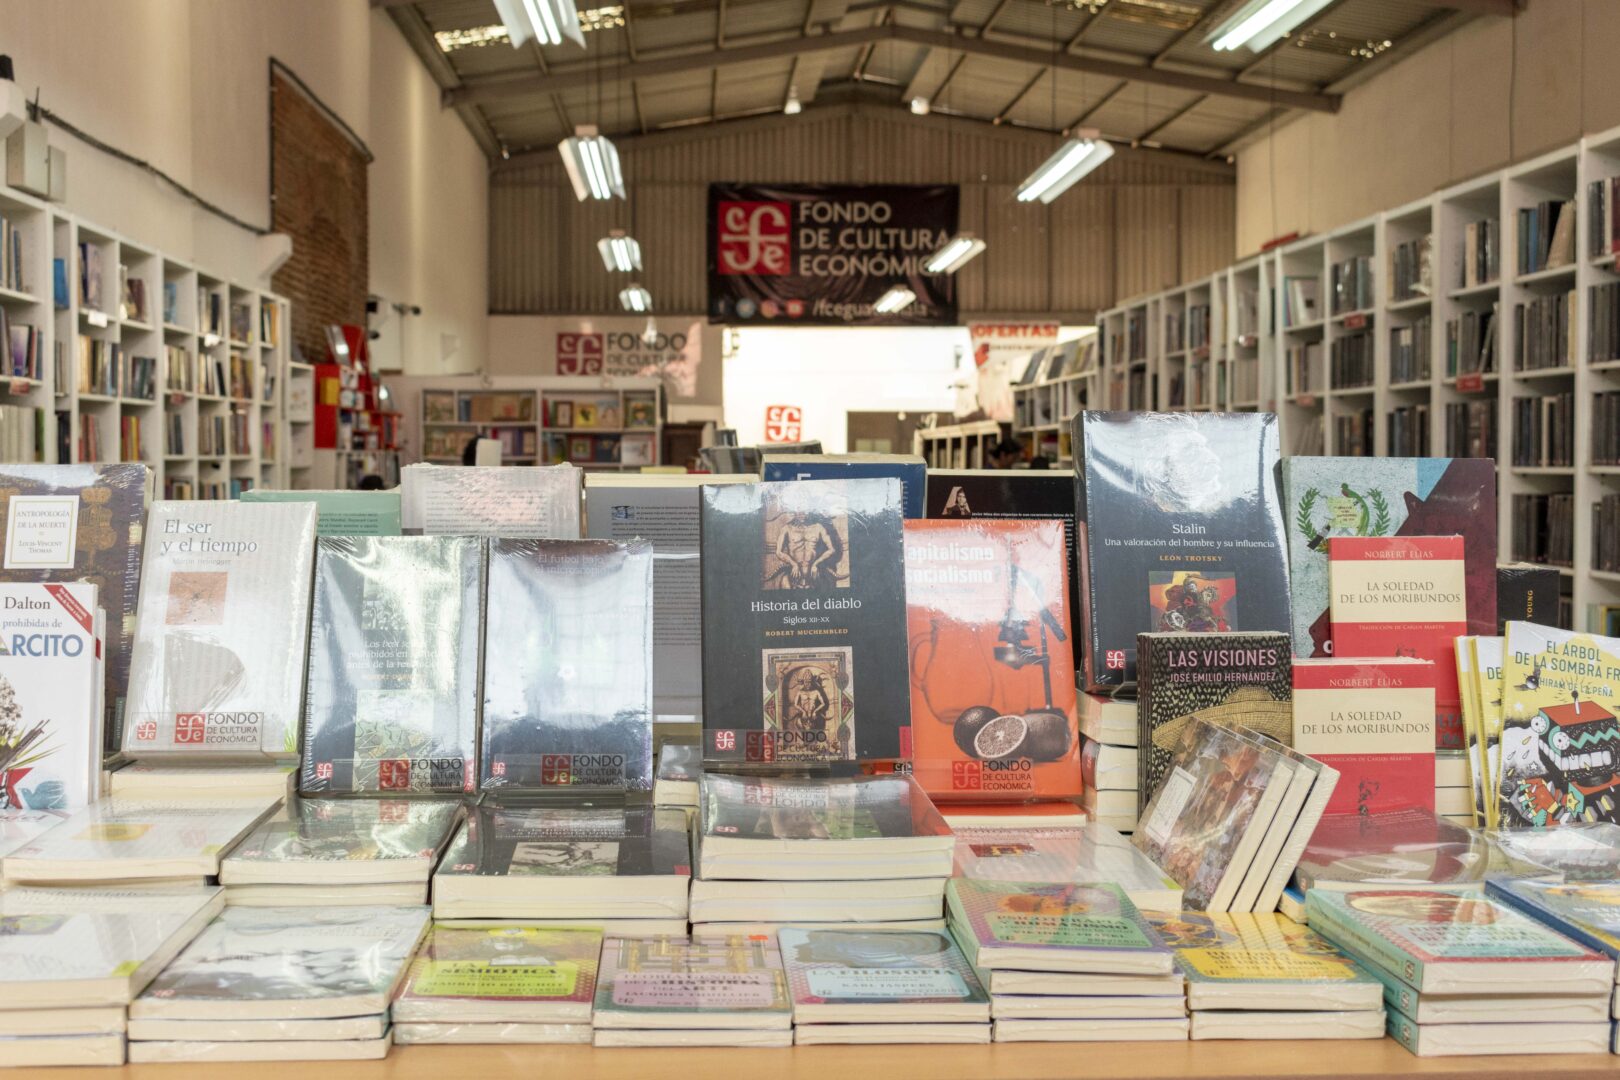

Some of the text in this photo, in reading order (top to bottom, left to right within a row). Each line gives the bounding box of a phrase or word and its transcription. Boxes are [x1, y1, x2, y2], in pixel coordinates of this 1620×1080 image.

[800, 201, 891, 224] FONDO
[800, 228, 950, 250] DE CULTURA
[800, 252, 938, 276] ECONÓMIC
[607, 332, 688, 351] FONDO
[17, 521, 67, 529] DE LA MUERTE
[164, 519, 213, 534] El ser
[1172, 523, 1206, 535] Stalin
[160, 537, 258, 556] y el tiempo
[1104, 538, 1122, 547] Una
[1123, 537, 1167, 547] valoración
[1168, 538, 1182, 547] del
[1183, 538, 1215, 548] hombre
[1216, 541, 1222, 549] y
[1235, 539, 1275, 548] influencia
[909, 542, 995, 563] apitalismo
[1364, 550, 1434, 559] NORBERT ELIAS
[1367, 581, 1434, 591] LA SOLEDAD
[4, 596, 51, 610] Dalton
[751, 597, 862, 612] Historia del diablo
[1340, 593, 1461, 604] DE LOS MORIBUNDOS
[1526, 589, 1534, 619] YOUNG
[2, 618, 63, 630] prohibidas de
[783, 615, 808, 626] Siglos
[797, 628, 849, 637] MUCHEMBLED
[1546, 640, 1602, 662] EL ÁRBOL
[1169, 649, 1277, 668] LAS VISIONES
[1515, 651, 1530, 666] DE
[1533, 654, 1547, 669] LA
[1551, 657, 1602, 679] SOMBRA
[1169, 670, 1276, 683] JOSÉ EMILIO HERNÁNDEZ
[1329, 678, 1403, 687] NORBERT ELIAS
[1539, 677, 1566, 690] HIRAM
[1592, 685, 1614, 698] PEÑA
[207, 712, 259, 725] FONDO
[1330, 711, 1402, 721] LA SOLEDAD
[207, 726, 258, 734] DE CULTURA
[1302, 723, 1430, 735] DE LOS MORIBUNDOS
[206, 734, 257, 743] ECONÓMICA
[776, 731, 827, 742] FONDO
[411, 758, 462, 771] FONDO
[573, 755, 623, 767] FONDO
[982, 760, 1031, 772] FONDO
[411, 771, 462, 780] DE CULTURA
[573, 767, 623, 776] DE CULTURA
[982, 773, 1032, 781] DE CULTURA
[982, 780, 1032, 790] ECONÓMICA
